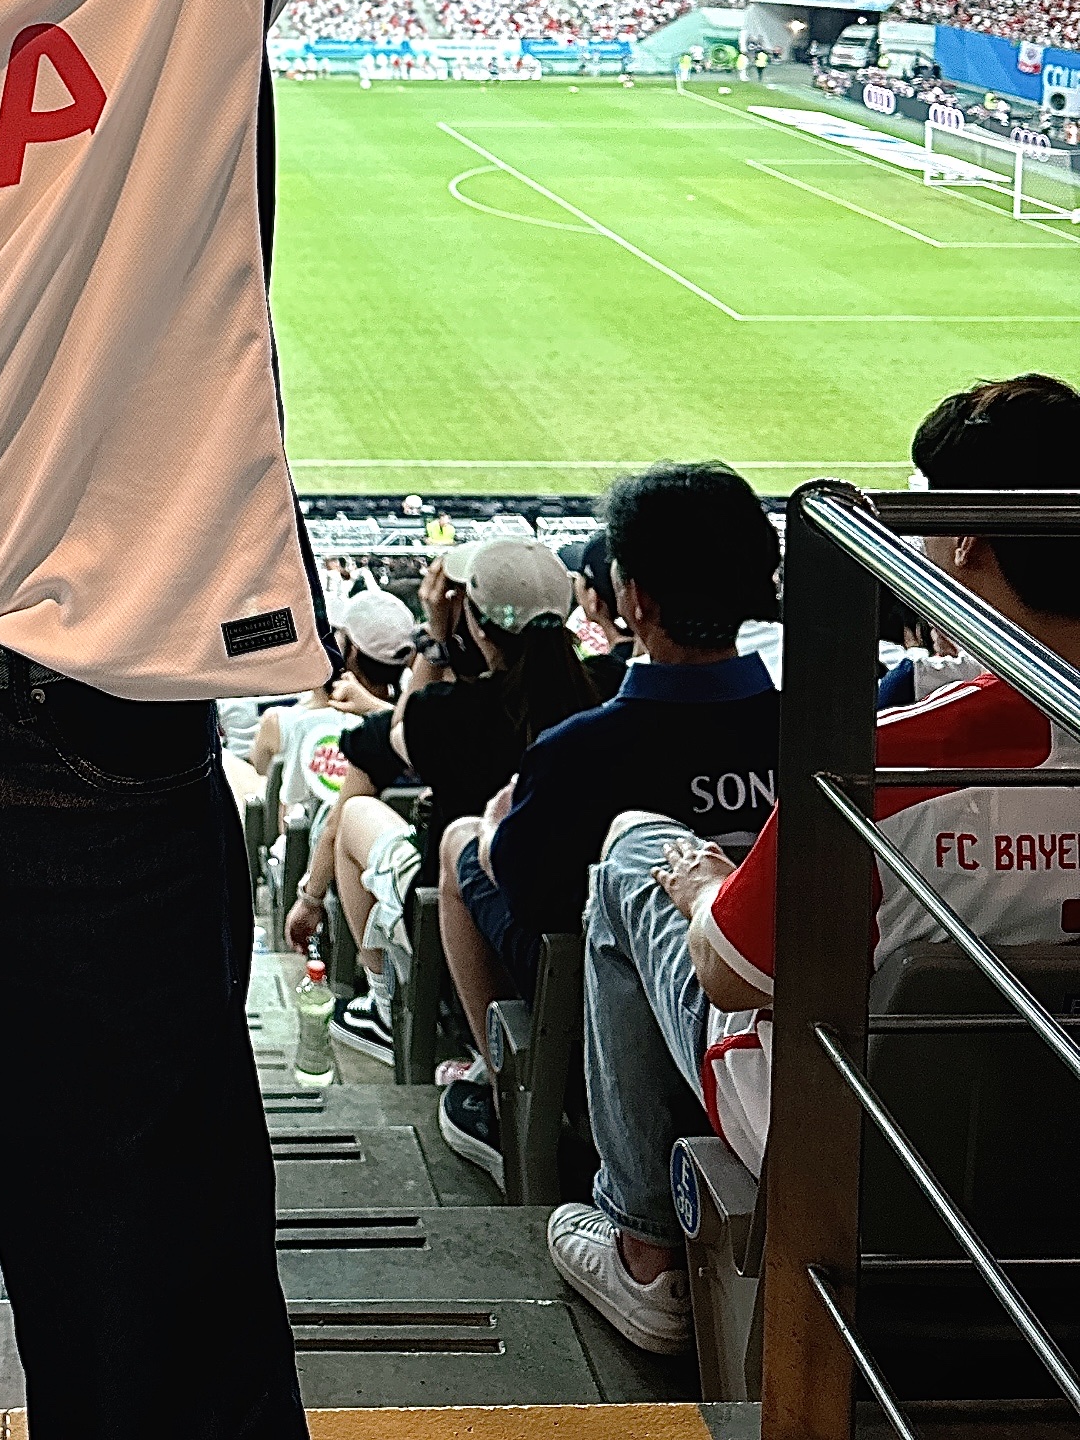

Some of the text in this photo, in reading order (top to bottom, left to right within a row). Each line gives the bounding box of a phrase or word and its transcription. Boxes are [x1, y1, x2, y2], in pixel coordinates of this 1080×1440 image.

[690, 769, 775, 814] SON
[935, 832, 1080, 871] FC BAYE
